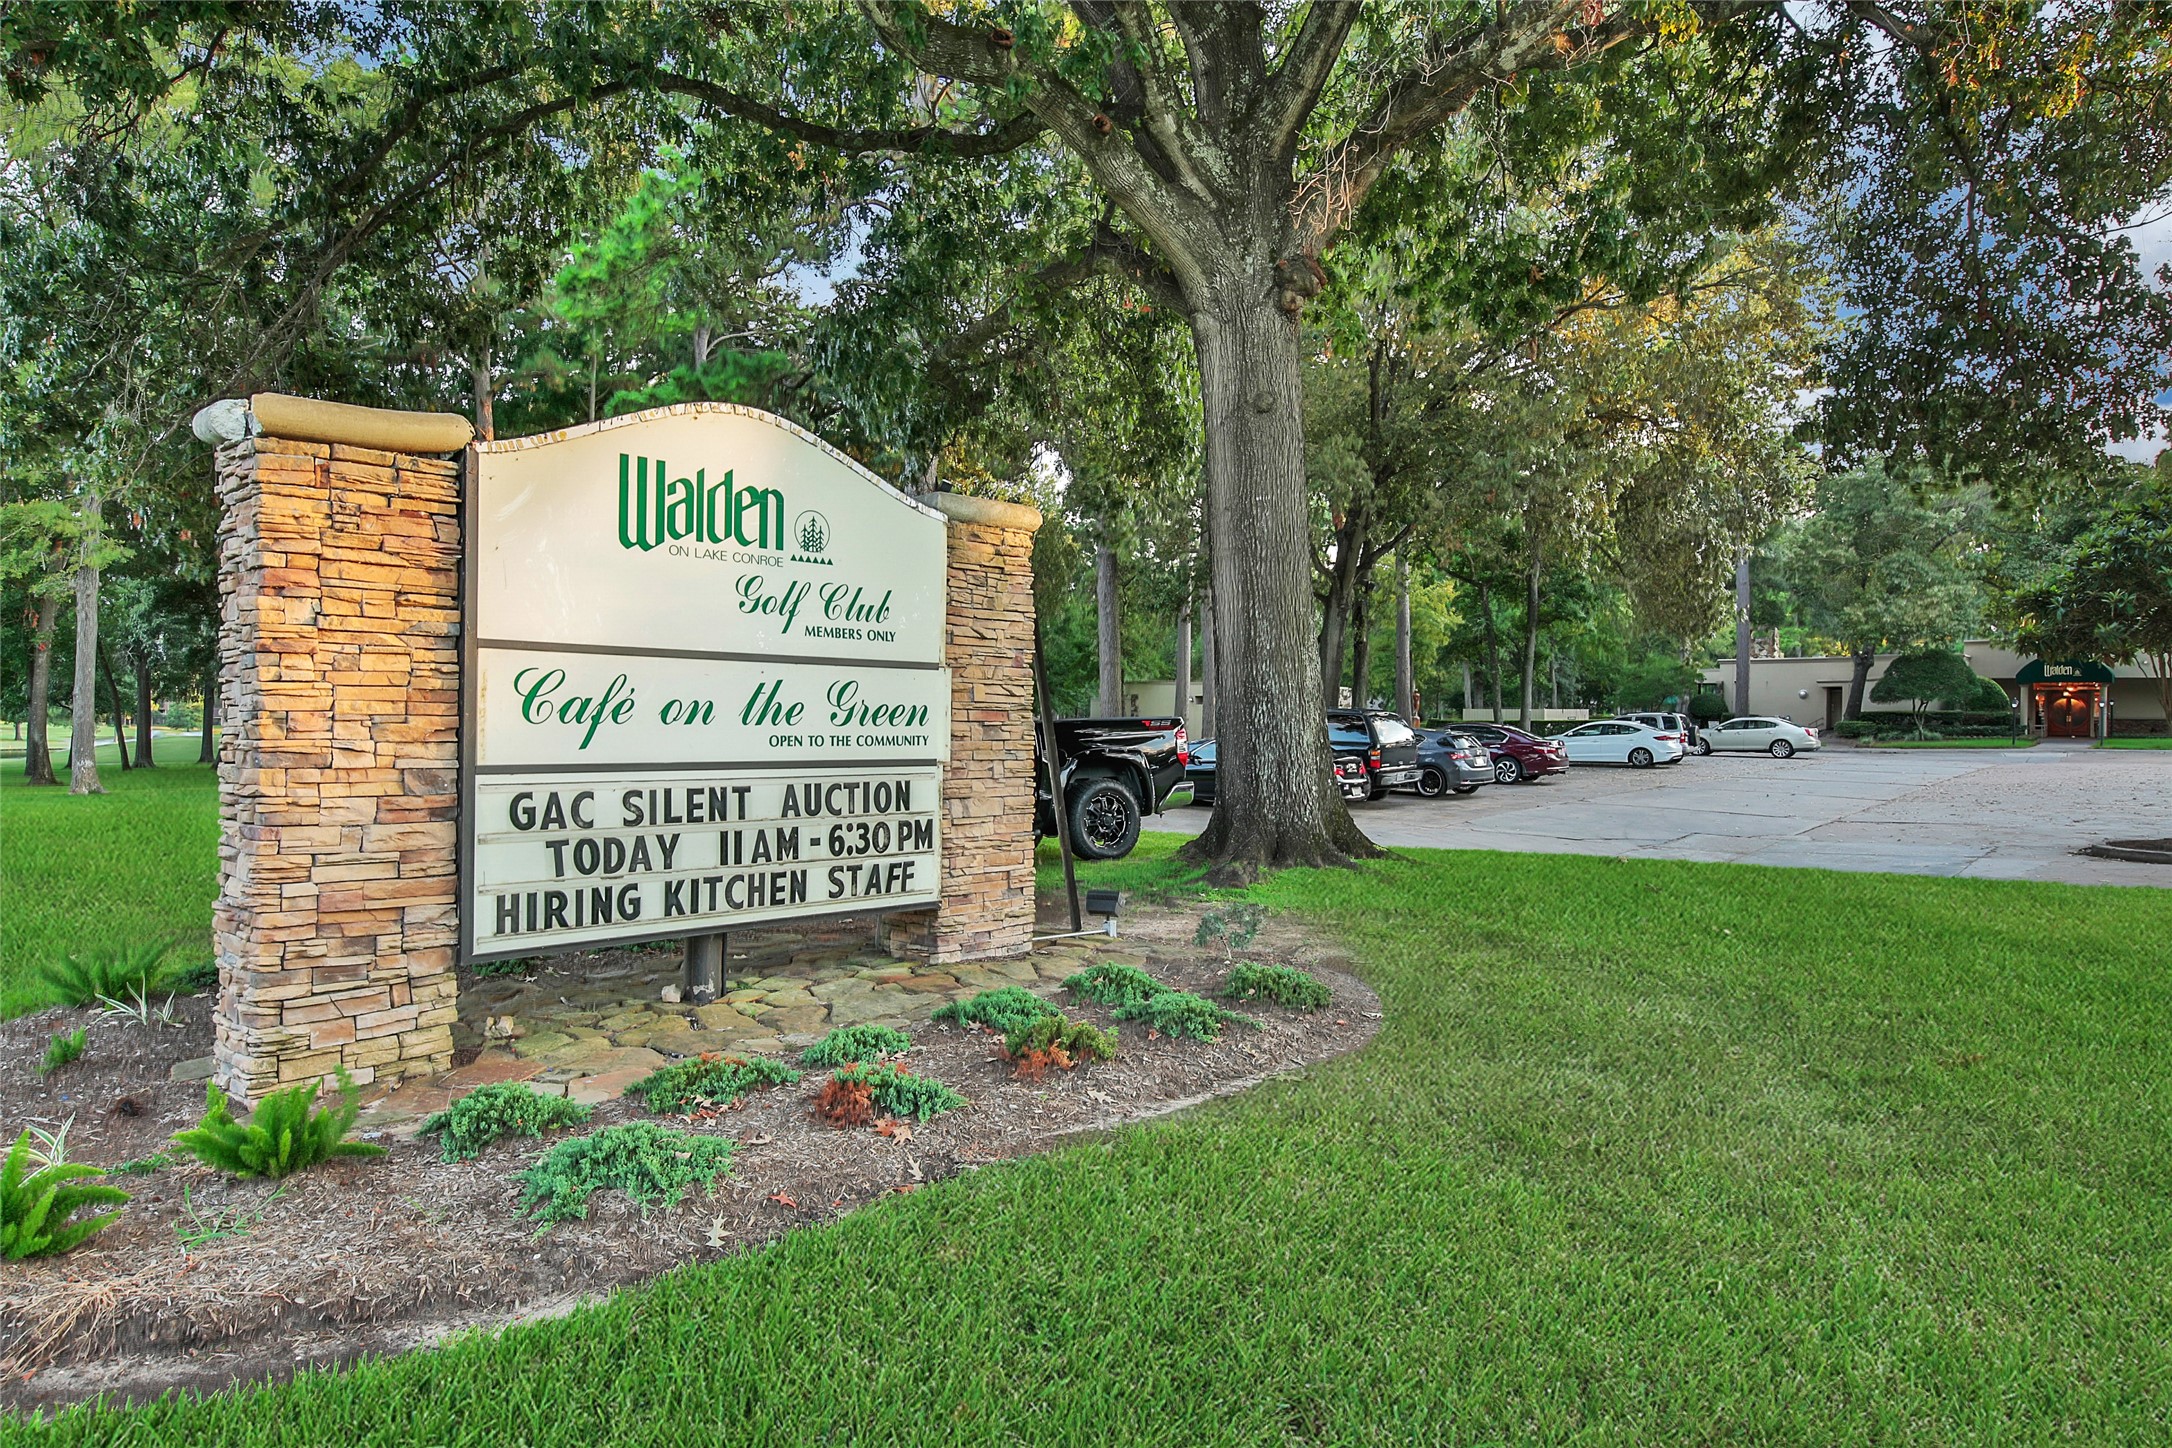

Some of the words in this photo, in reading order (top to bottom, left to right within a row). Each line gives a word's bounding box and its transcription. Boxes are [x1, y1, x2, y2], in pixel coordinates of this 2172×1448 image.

[618, 453, 785, 552] Walden
[668, 545, 690, 558] ON
[694, 547, 728, 563] LAKE
[732, 551, 785, 568] CONROE
[735, 574, 812, 635] Golf
[819, 582, 893, 624] Club
[804, 625, 863, 643] MEMBERS
[866, 629, 897, 644] ONLY
[2044, 664, 2073, 677] Walden
[513, 667, 636, 751] Café
[658, 698, 717, 726] on
[738, 678, 805, 727] the
[826, 679, 930, 728] Green
[768, 734, 803, 748] OPEN
[807, 734, 825, 748] TO
[829, 734, 852, 748] THE
[855, 734, 930, 748] COMMUNITY
[509, 791, 596, 831] GAC
[622, 786, 752, 827] SILENT
[781, 780, 911, 818] AUCTION
[545, 833, 681, 878] TODAY
[496, 883, 642, 935] HIRING
[664, 869, 808, 917] KITCHEN
[828, 860, 916, 899] STAFF
